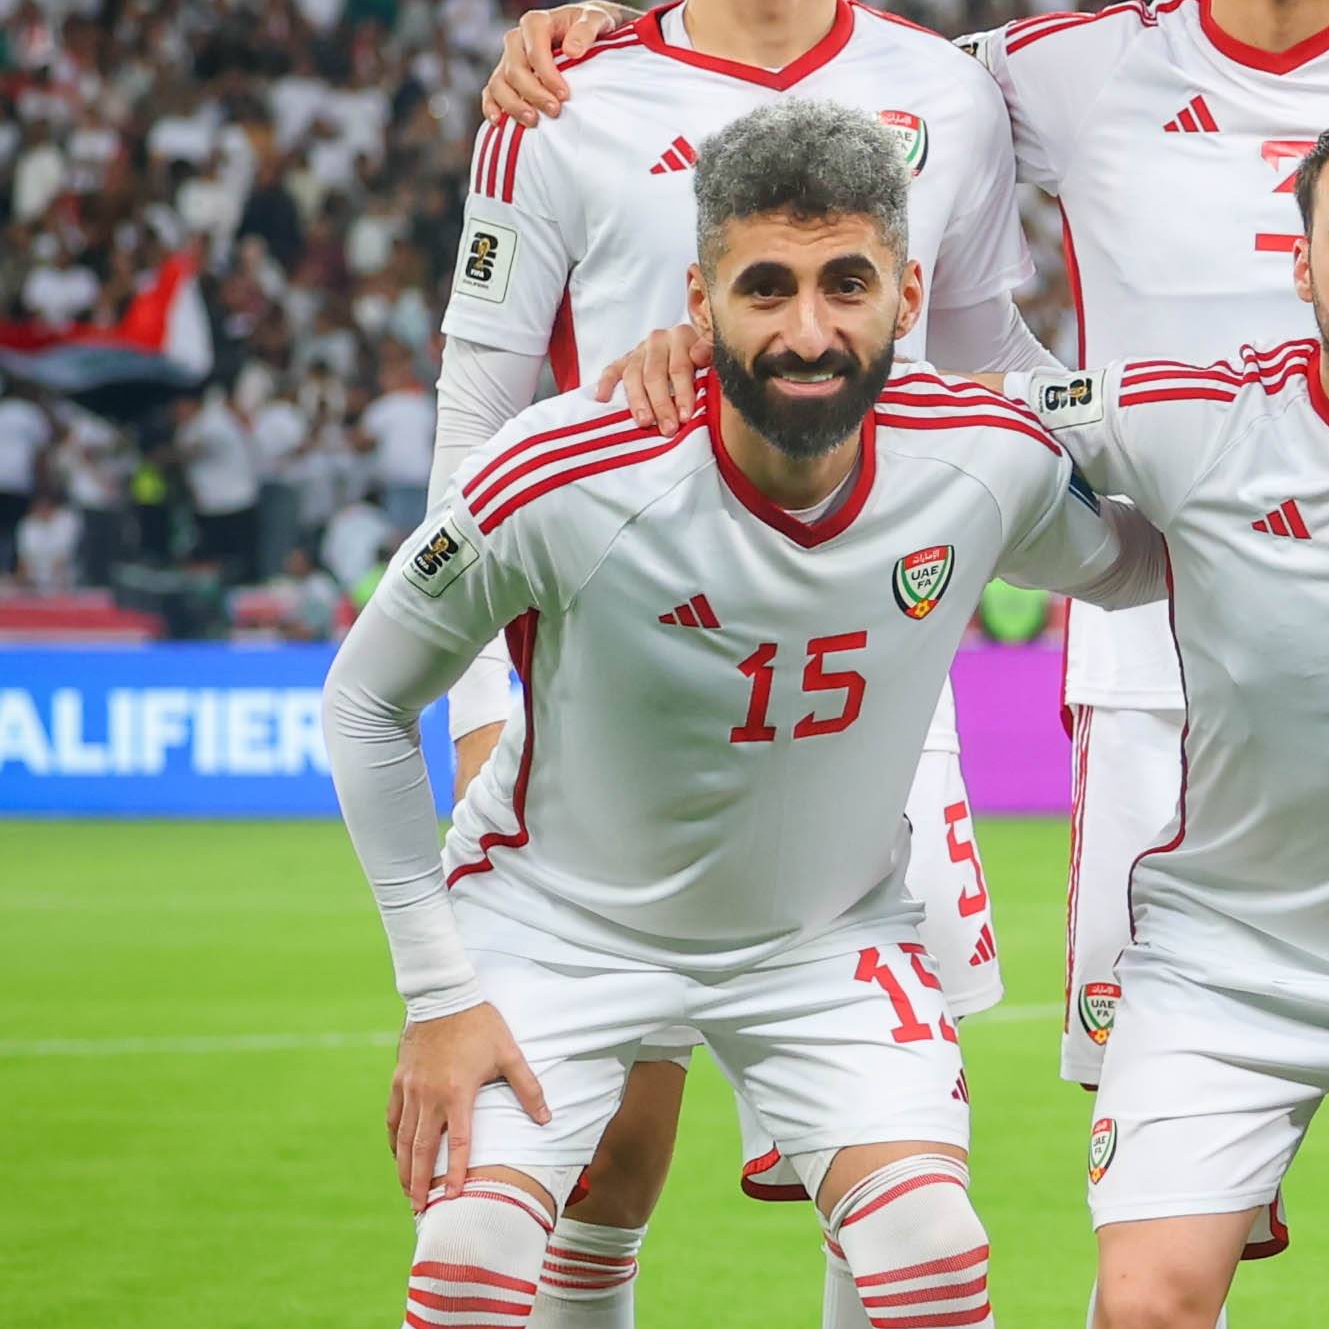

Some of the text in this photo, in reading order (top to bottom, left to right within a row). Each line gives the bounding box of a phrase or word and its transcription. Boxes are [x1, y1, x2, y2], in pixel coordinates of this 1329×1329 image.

[911, 564, 939, 582] UAE
[917, 579, 933, 590] FA
[730, 630, 867, 743] 15
[944, 800, 987, 918] 5
